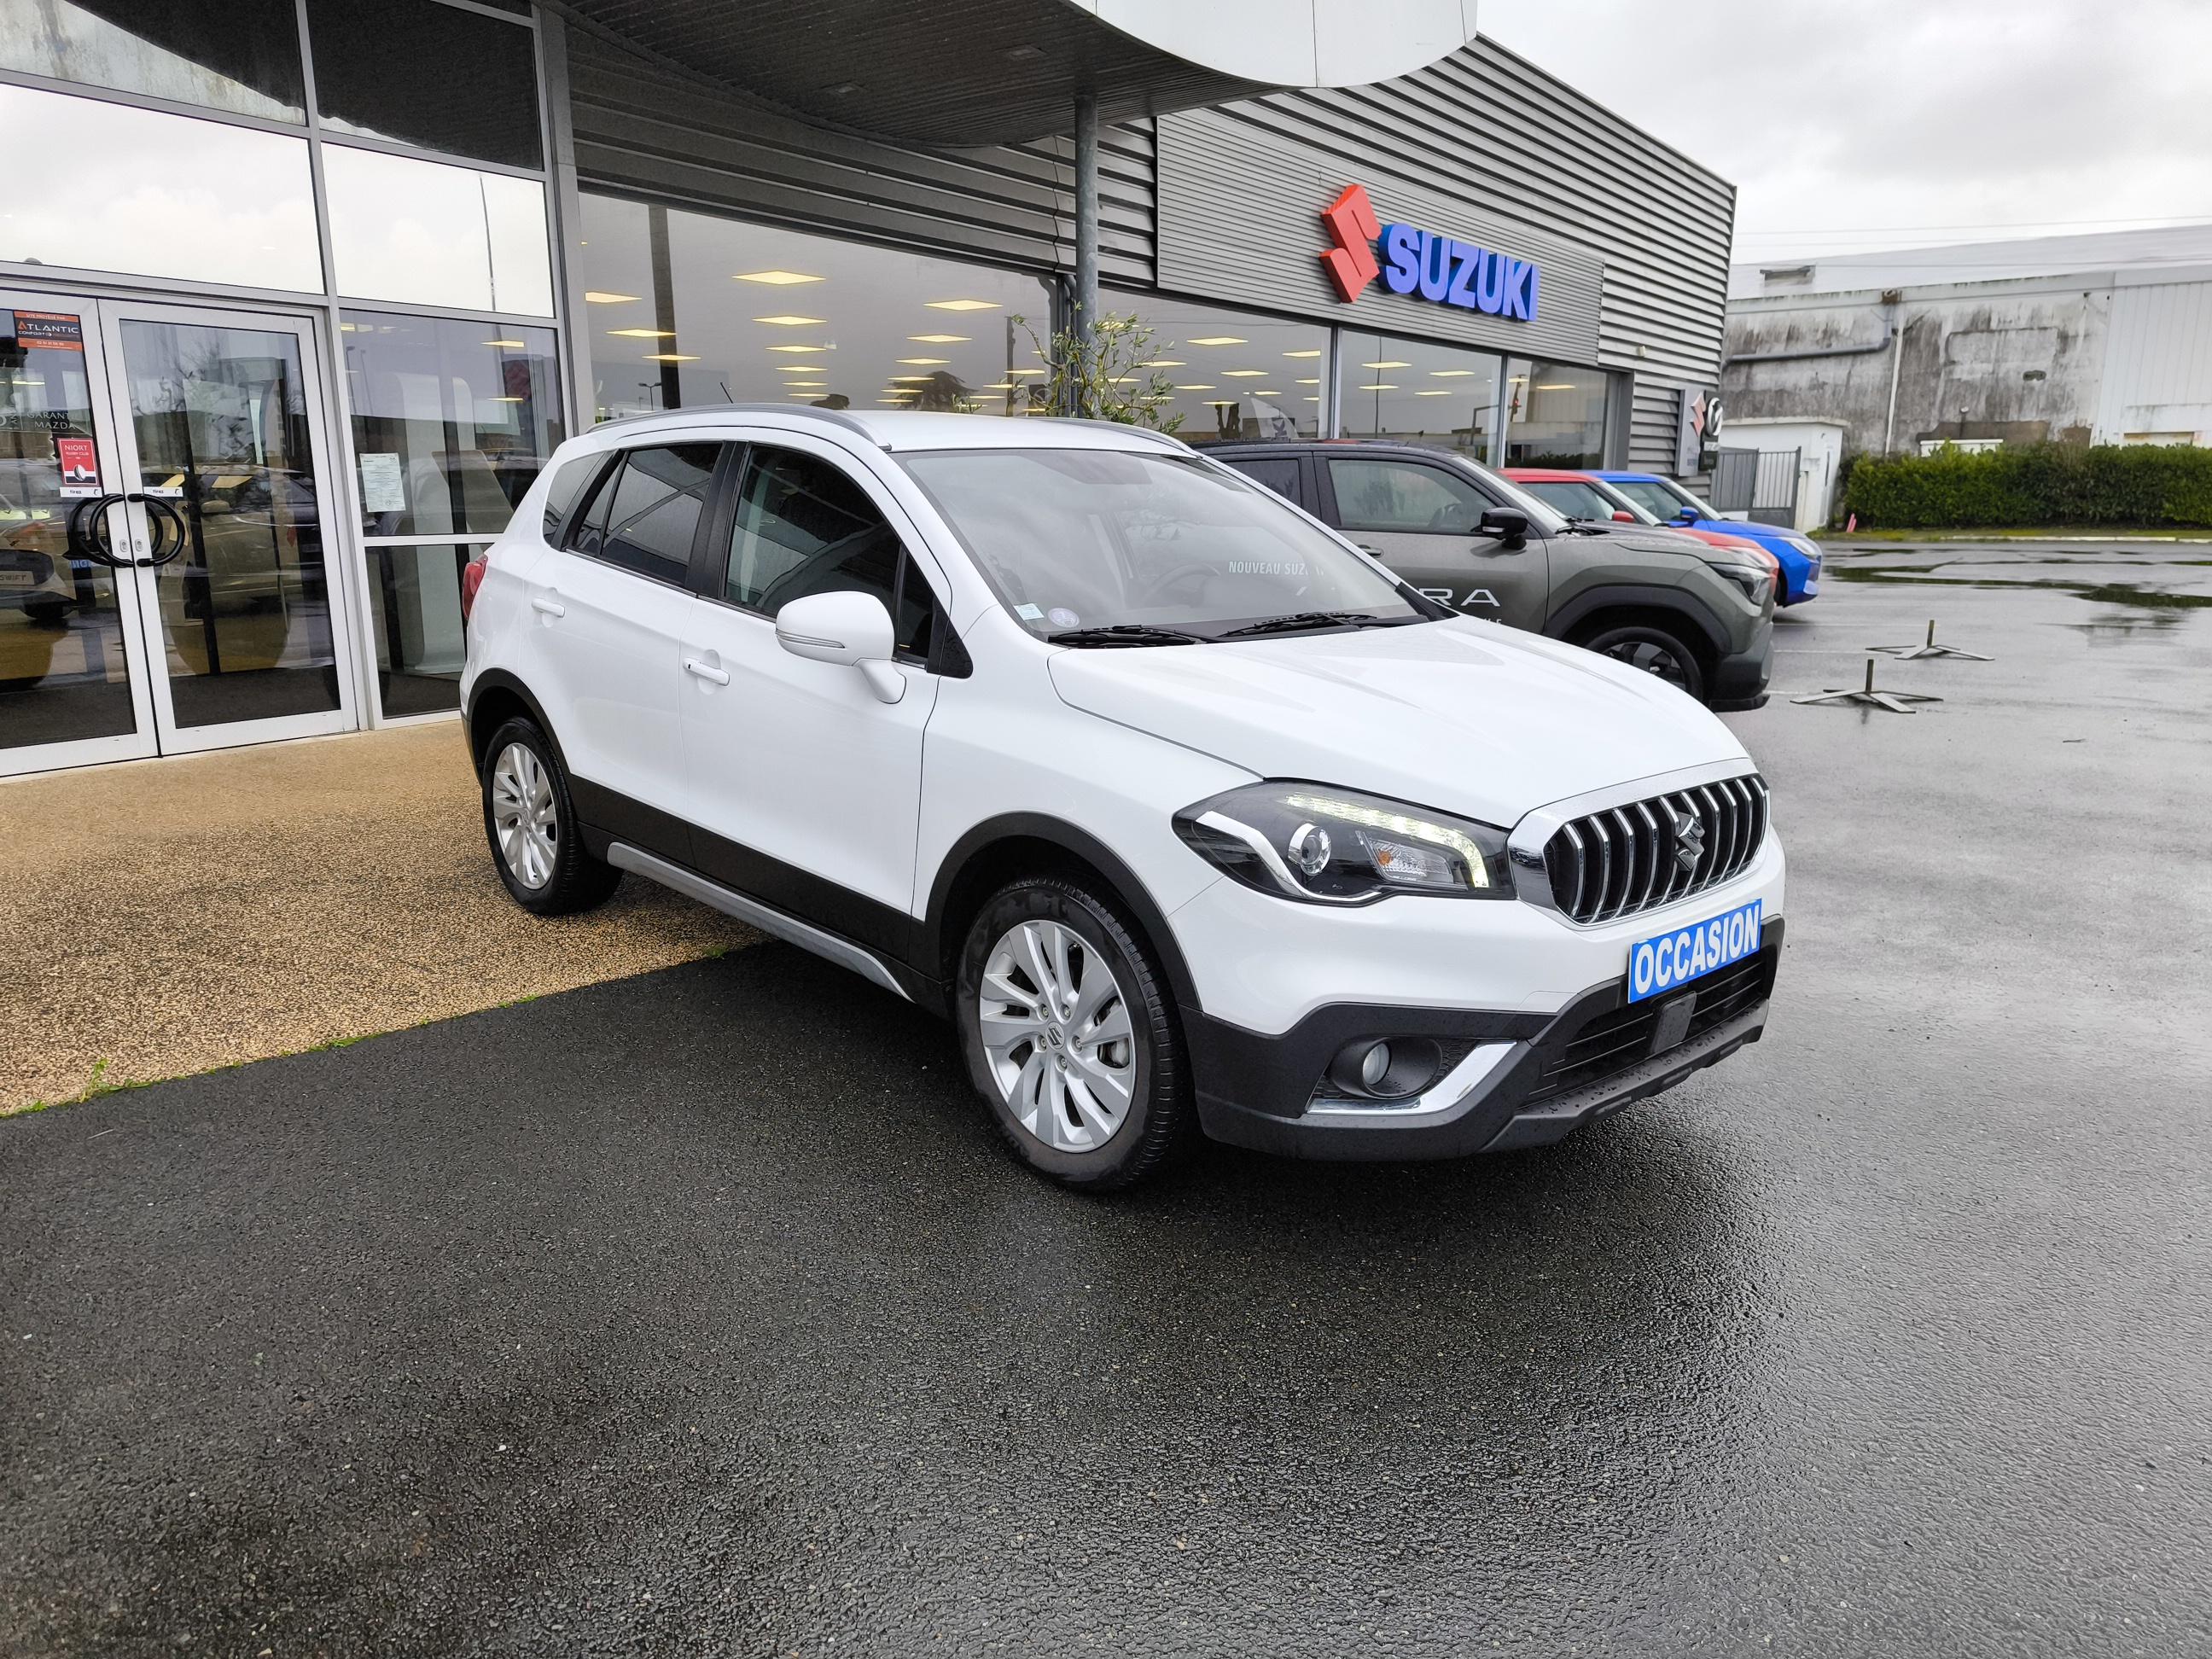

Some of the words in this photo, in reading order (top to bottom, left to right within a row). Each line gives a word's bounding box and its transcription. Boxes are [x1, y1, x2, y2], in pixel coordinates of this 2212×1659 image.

[1378, 223, 1540, 322] SUZUKI
[18, 321, 79, 334] ATLANTIC
[35, 421, 76, 429] MAZDA
[1229, 561, 1280, 574] NOUVEAU
[1634, 904, 1760, 995] OCCASION
